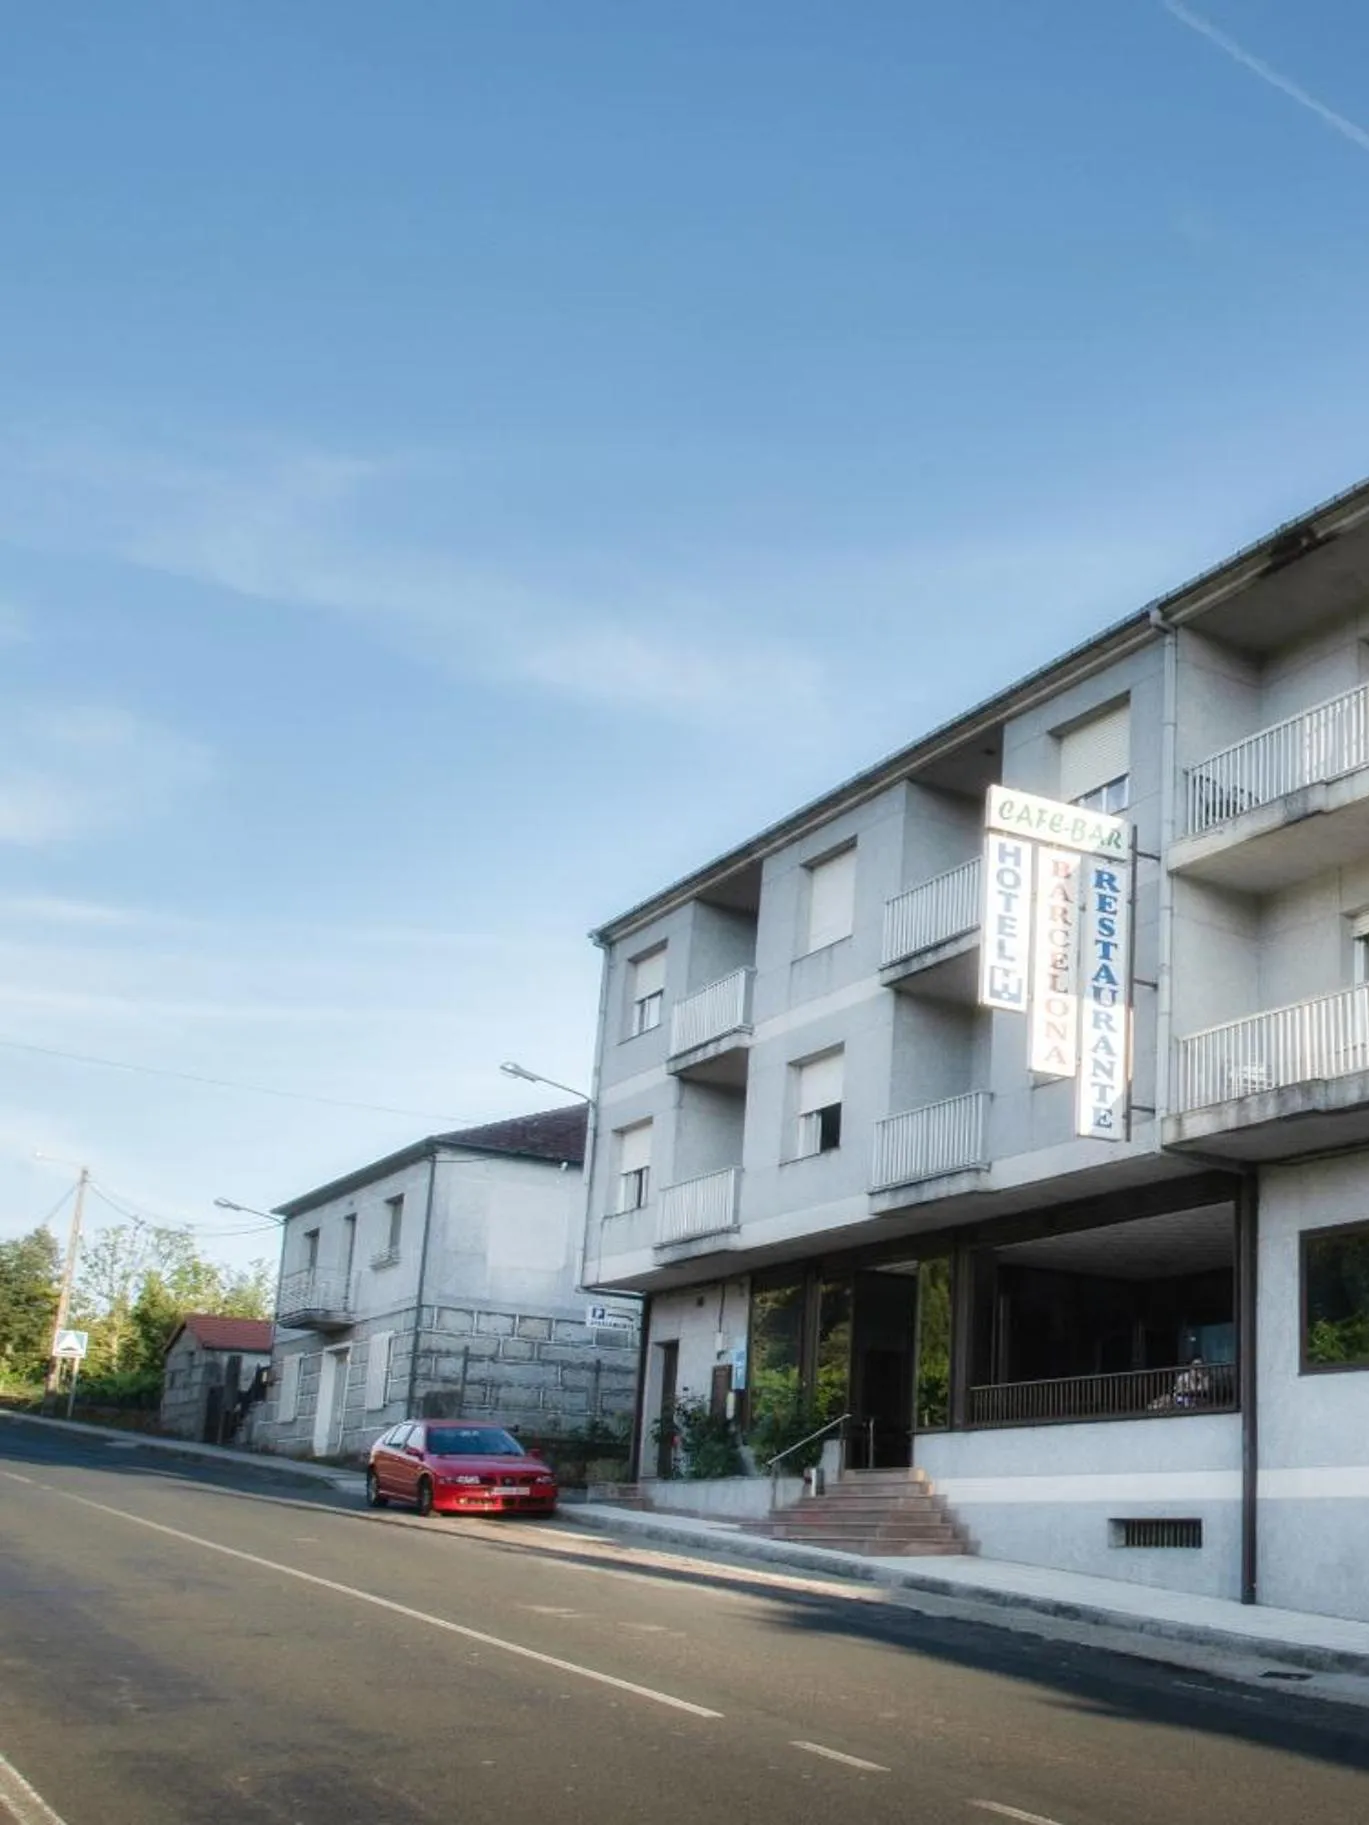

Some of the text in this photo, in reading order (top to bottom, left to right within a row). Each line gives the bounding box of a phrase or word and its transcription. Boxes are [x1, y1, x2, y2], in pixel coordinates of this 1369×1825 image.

[996, 842, 1022, 962] HOTEL
[1043, 860, 1074, 1066] BARCELONA
[1091, 868, 1120, 1129] RESTAURANTE
